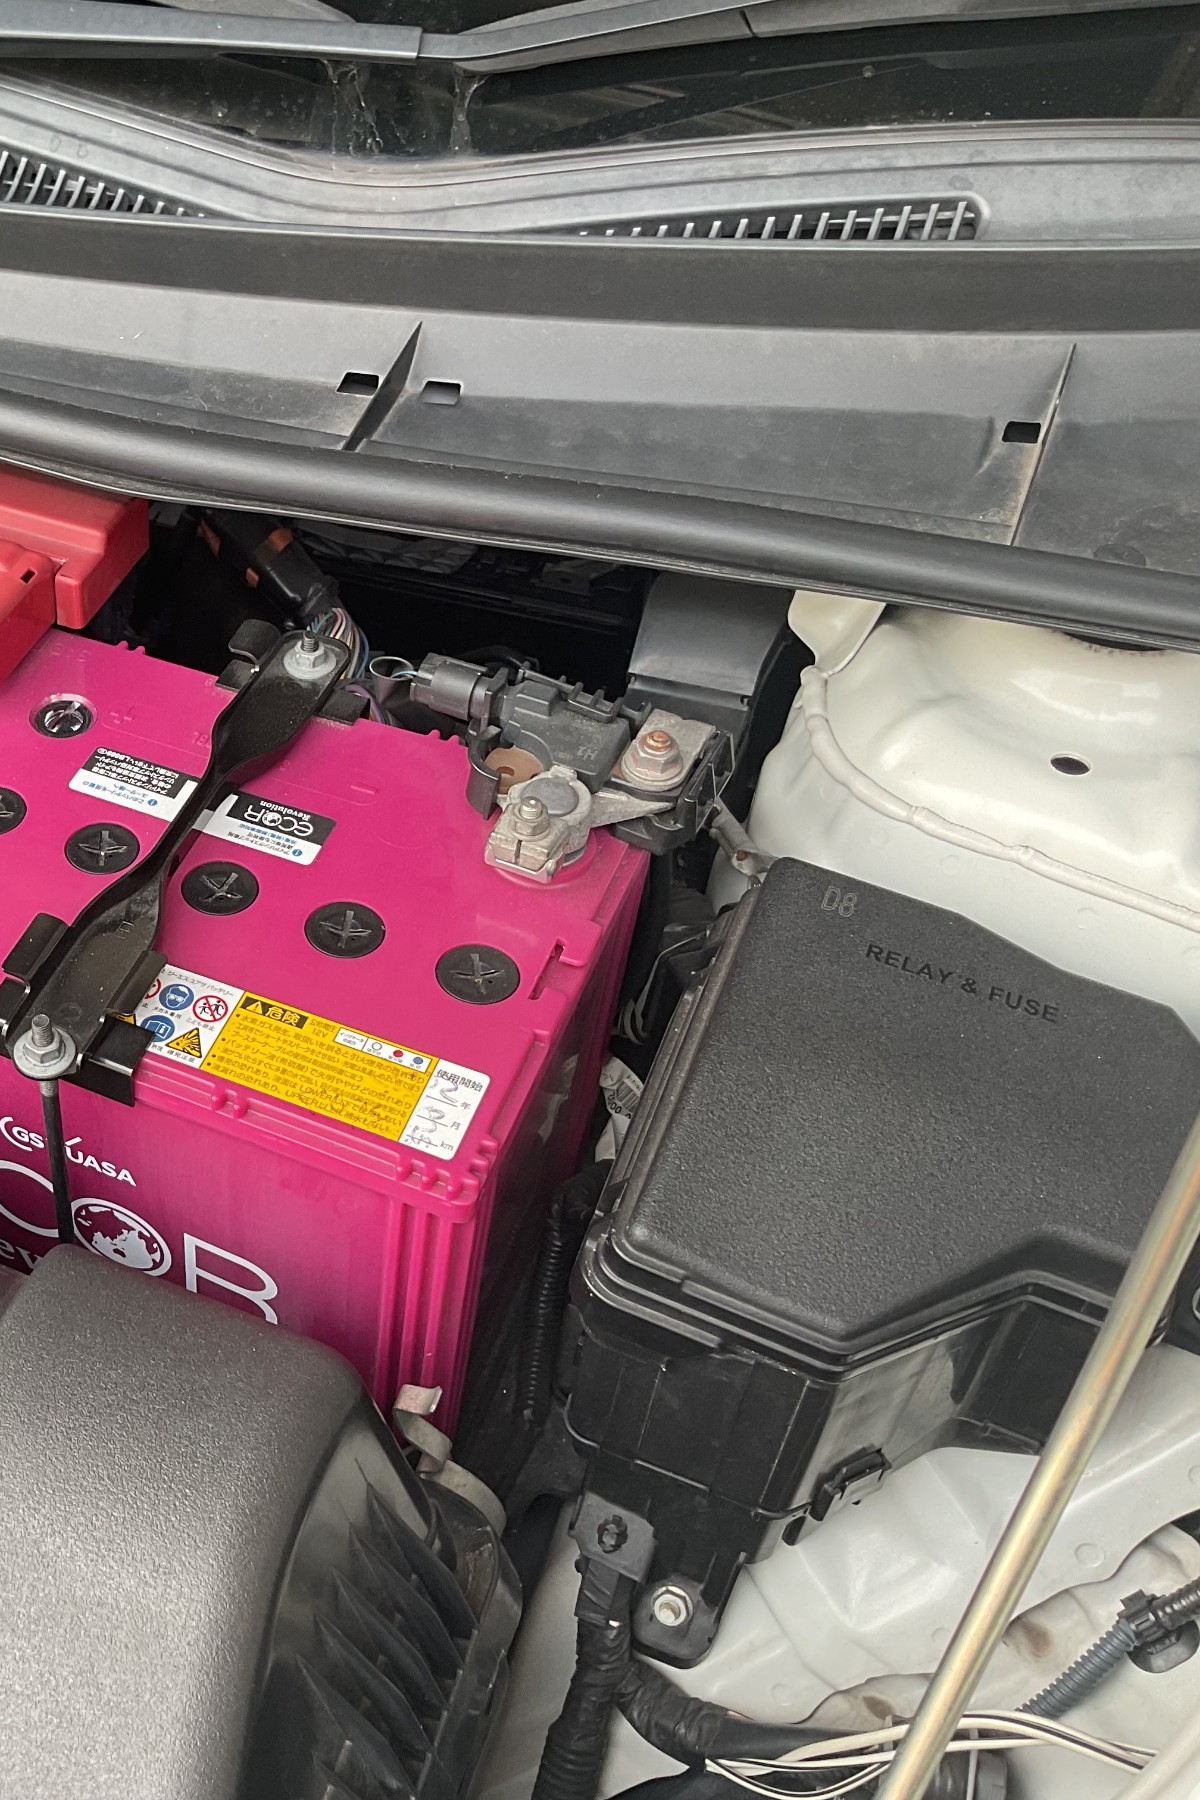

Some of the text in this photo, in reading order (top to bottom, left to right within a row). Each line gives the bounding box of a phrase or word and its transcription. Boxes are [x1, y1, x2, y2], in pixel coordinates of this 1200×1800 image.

[259, 800, 311, 821] Revolution
[820, 885, 858, 918] D8
[865, 943, 1060, 1023] RELAY & FUSE
[265, 1005, 301, 1027] 危険
[436, 1068, 483, 1092] 使用開始
[460, 1101, 471, 1110] 年
[450, 1121, 461, 1130] 月
[440, 1141, 454, 1152] km
